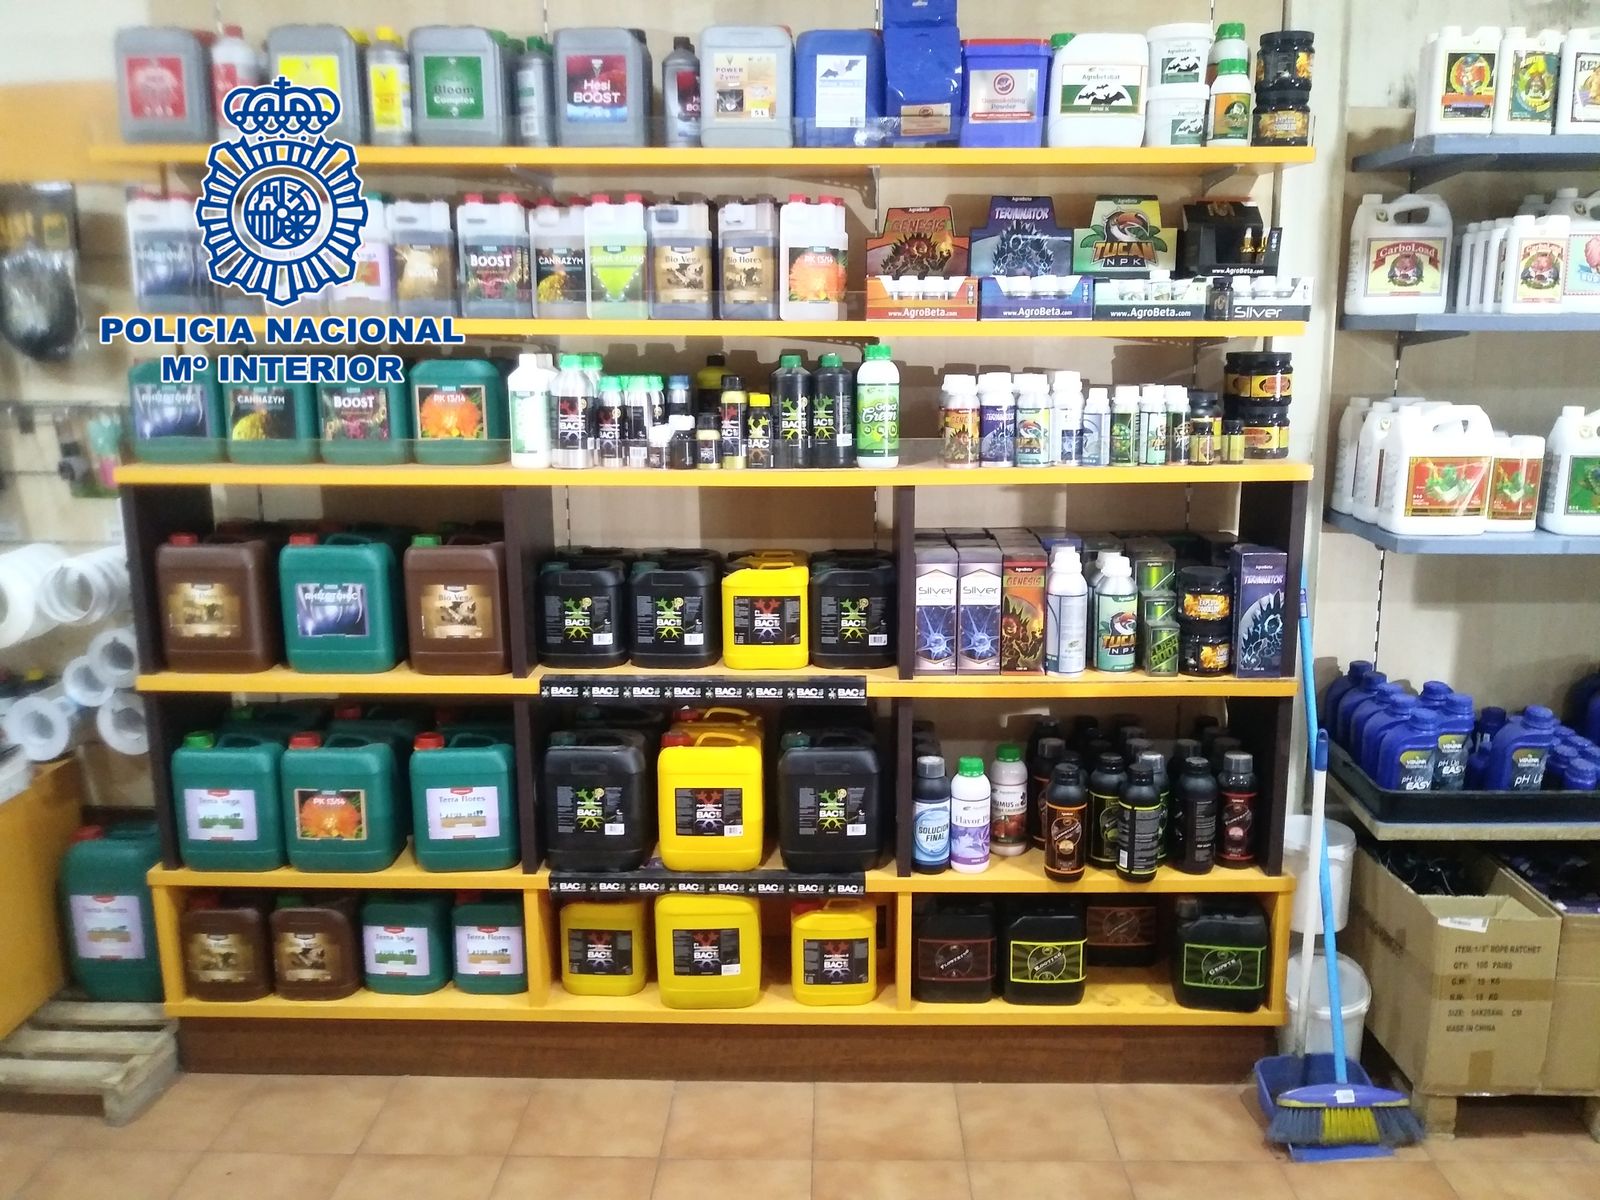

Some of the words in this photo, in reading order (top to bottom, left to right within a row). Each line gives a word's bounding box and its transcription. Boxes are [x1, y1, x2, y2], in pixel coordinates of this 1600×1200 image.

[583, 79, 611, 91] Hesi
[573, 91, 622, 104] BOOST
[994, 206, 1050, 221] TERMINATOR
[891, 218, 945, 232] GENESIS
[1093, 241, 1158, 261] TUCAN
[1378, 243, 1436, 259] CarboLoad
[470, 254, 513, 268] BOOST
[537, 256, 584, 266] CANNAZYM
[888, 307, 958, 318] www.AgroBeta.com
[1002, 306, 1073, 318] www.AgroBeta.com
[1110, 307, 1192, 318] www.AgroBeta.com
[1234, 306, 1282, 318] Silver
[333, 396, 375, 409] BOOST
[1006, 575, 1042, 588] GENESIS
[918, 586, 953, 595] Silver
[962, 585, 999, 595] Silver
[1442, 765, 1466, 775] EASY
[1406, 780, 1432, 791] EASY
[1514, 774, 1532, 786] pH
[925, 832, 945, 842] FINAL
